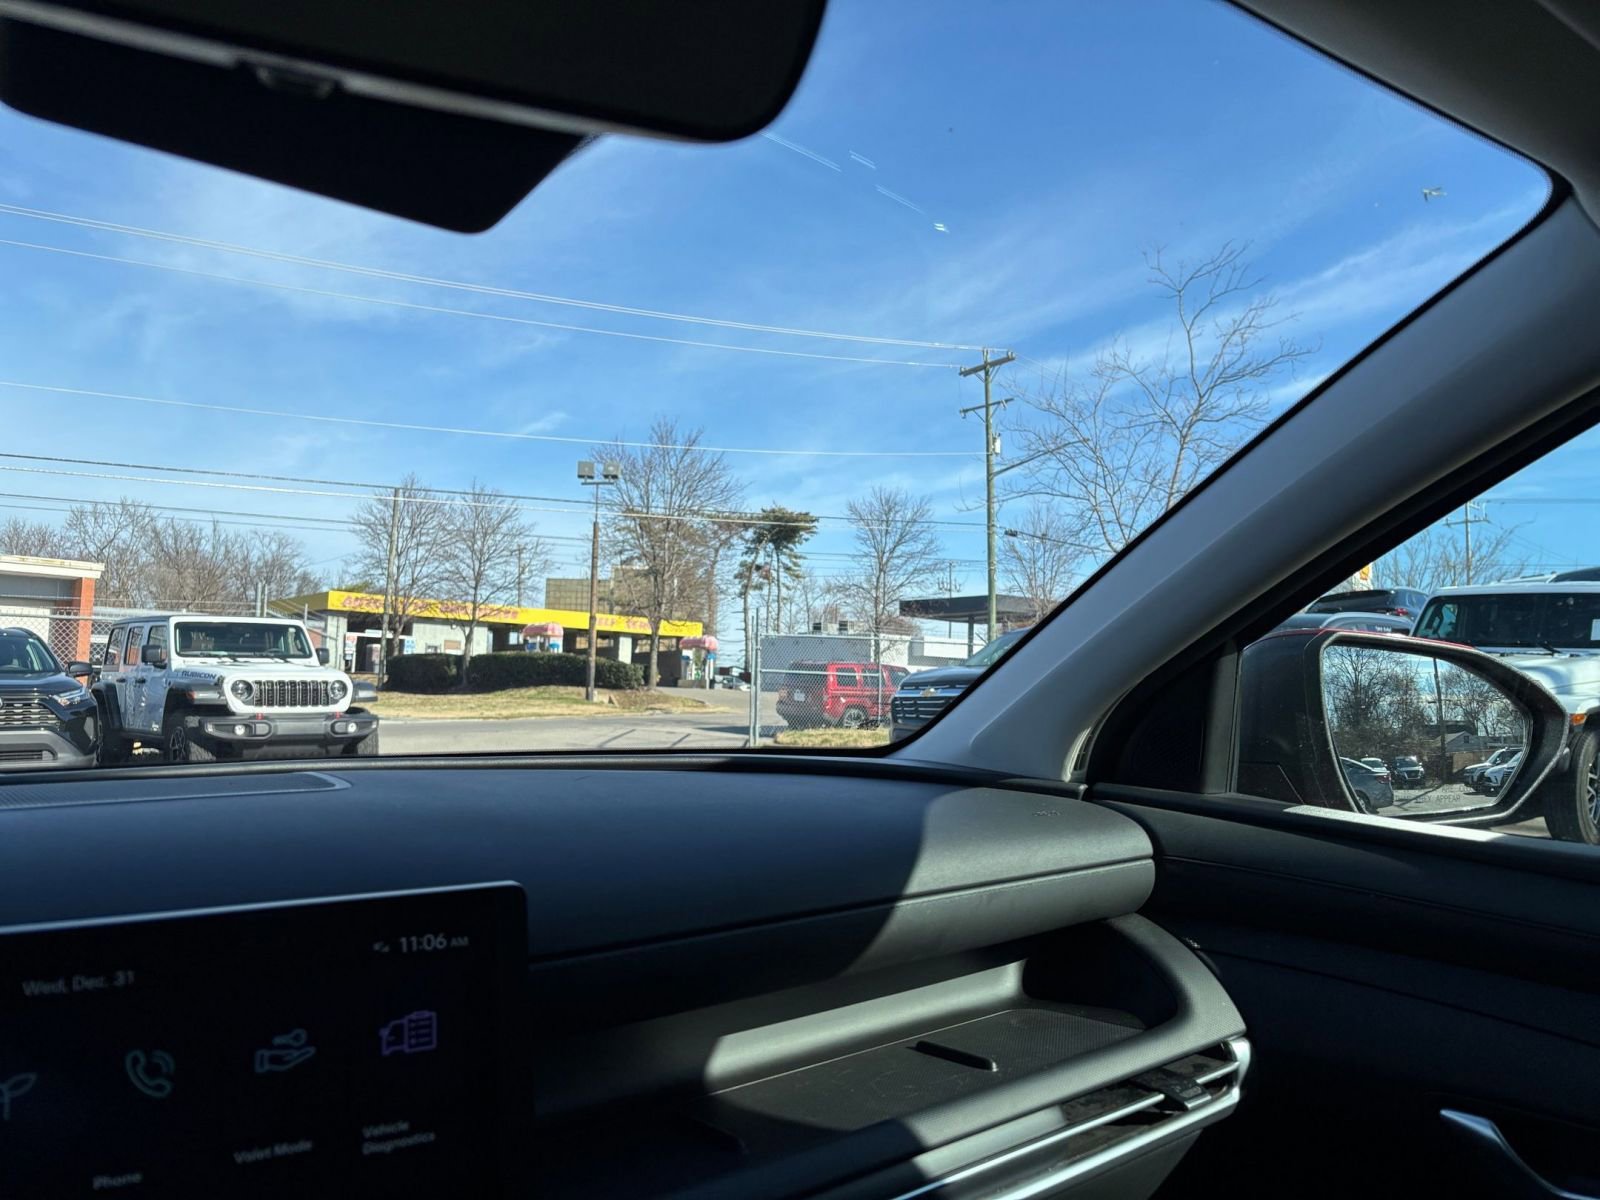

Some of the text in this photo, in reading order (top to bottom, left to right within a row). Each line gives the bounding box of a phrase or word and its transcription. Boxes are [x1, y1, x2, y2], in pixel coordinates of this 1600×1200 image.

[182, 671, 217, 680] RUBICON
[1436, 794, 1461, 802] APPEAR
[400, 932, 470, 953] 11:06 AM
[113, 970, 136, 987] 31
[363, 1120, 410, 1138] Vehicle
[233, 1140, 314, 1165] Valet Mode
[363, 1131, 437, 1156] Diagnostics
[93, 1173, 144, 1191] Phone
